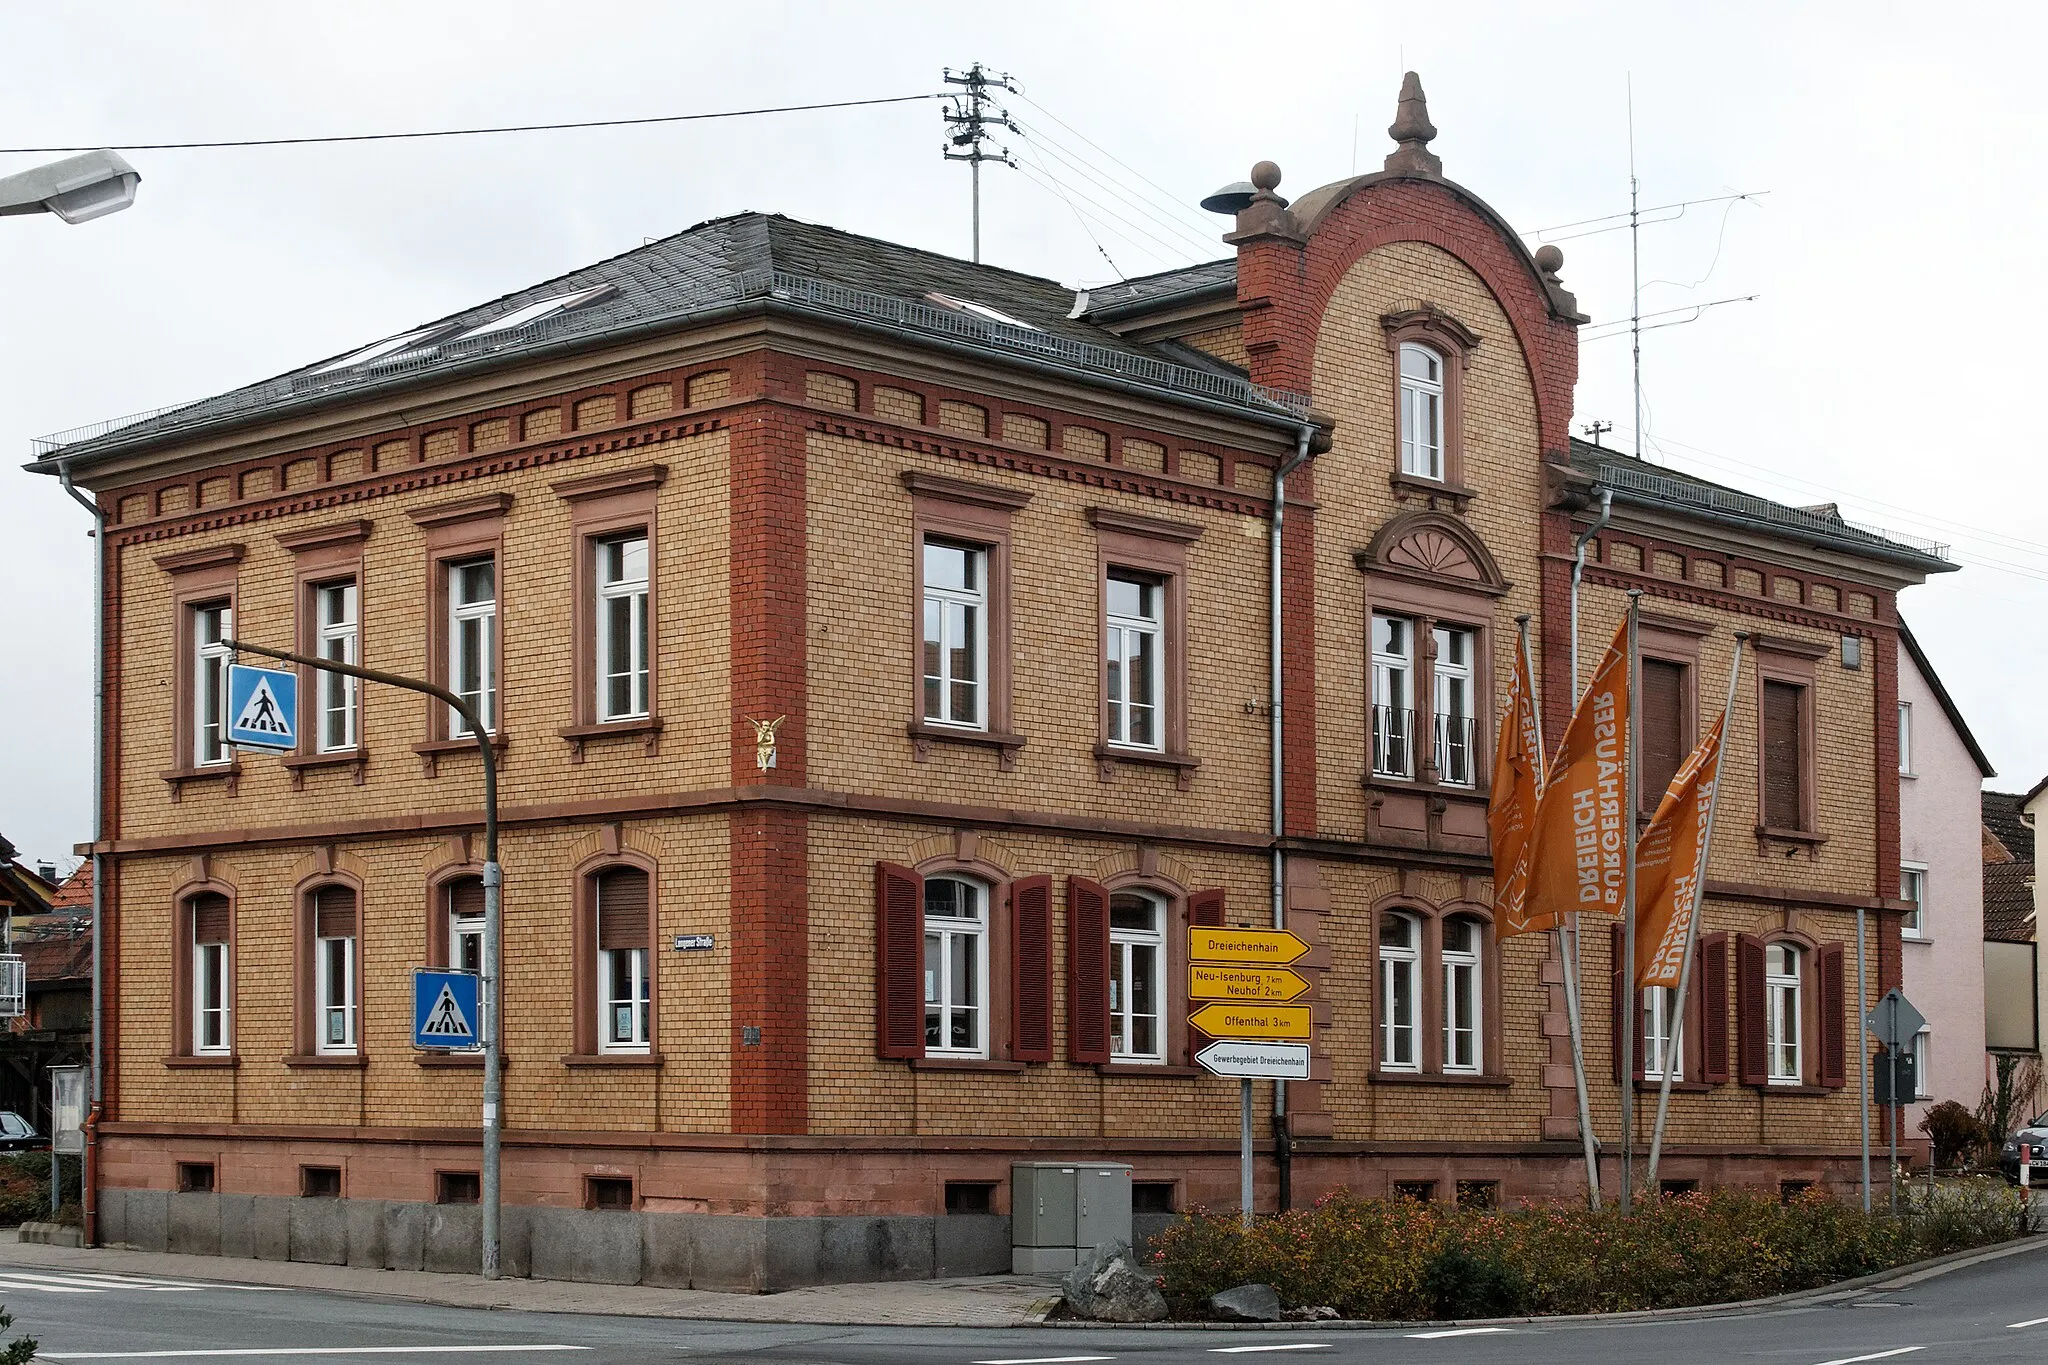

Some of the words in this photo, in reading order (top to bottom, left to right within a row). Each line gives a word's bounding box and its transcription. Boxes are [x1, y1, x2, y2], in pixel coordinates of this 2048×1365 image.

[1208, 940, 1278, 953] Dreieichenhain
[1196, 970, 1261, 985] Neu-Isenburg
[1227, 985, 1261, 996] Neuhof
[1225, 1015, 1268, 1027] Offenthal
[1214, 1054, 1259, 1066] Gewerbegebiet
[1260, 1056, 1305, 1066] Dreieichenhain
